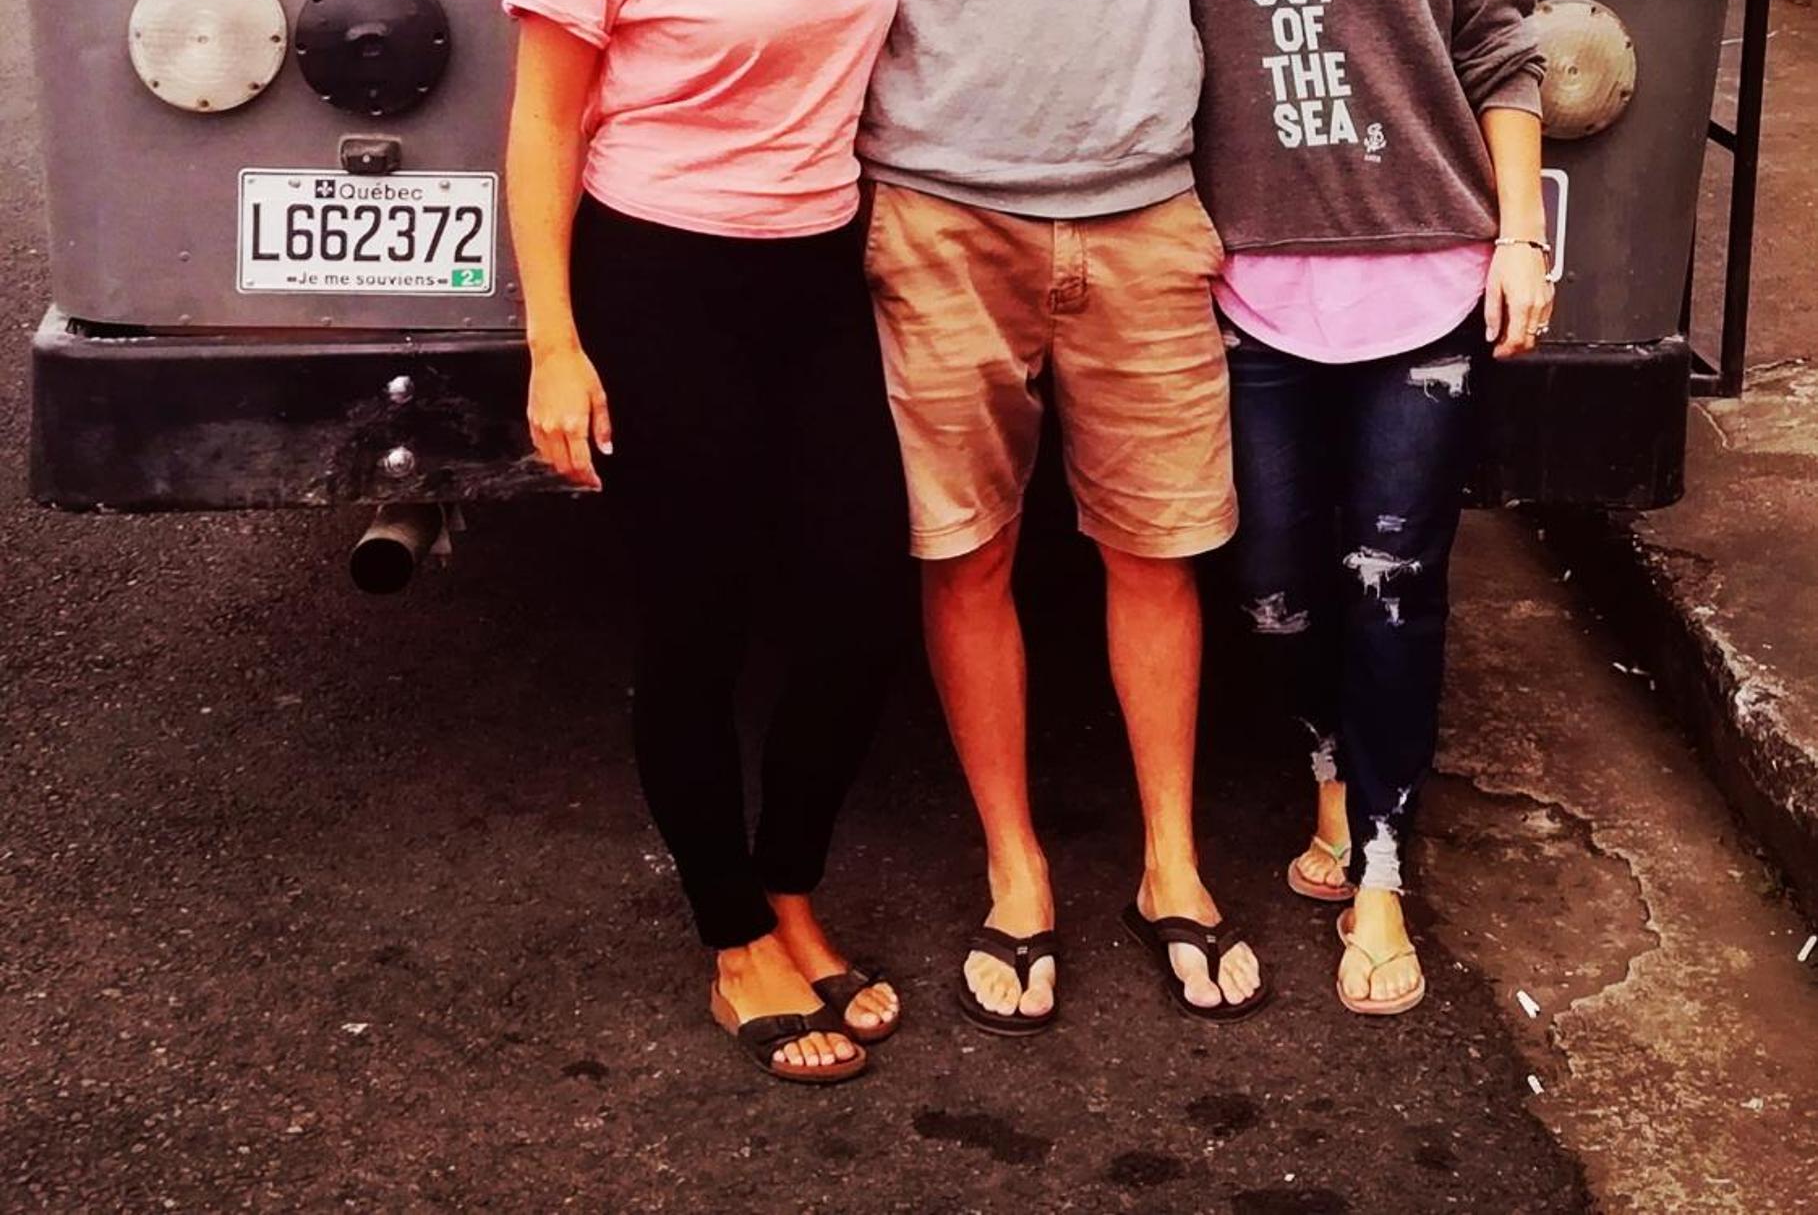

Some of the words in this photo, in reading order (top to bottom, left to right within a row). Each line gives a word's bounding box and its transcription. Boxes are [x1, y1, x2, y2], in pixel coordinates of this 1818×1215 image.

[1271, 6, 1325, 52] OF
[1262, 52, 1352, 101] THE
[1273, 99, 1359, 149] SEA
[339, 182, 424, 201] Québec
[252, 202, 484, 264] L662372
[324, 274, 350, 286] me
